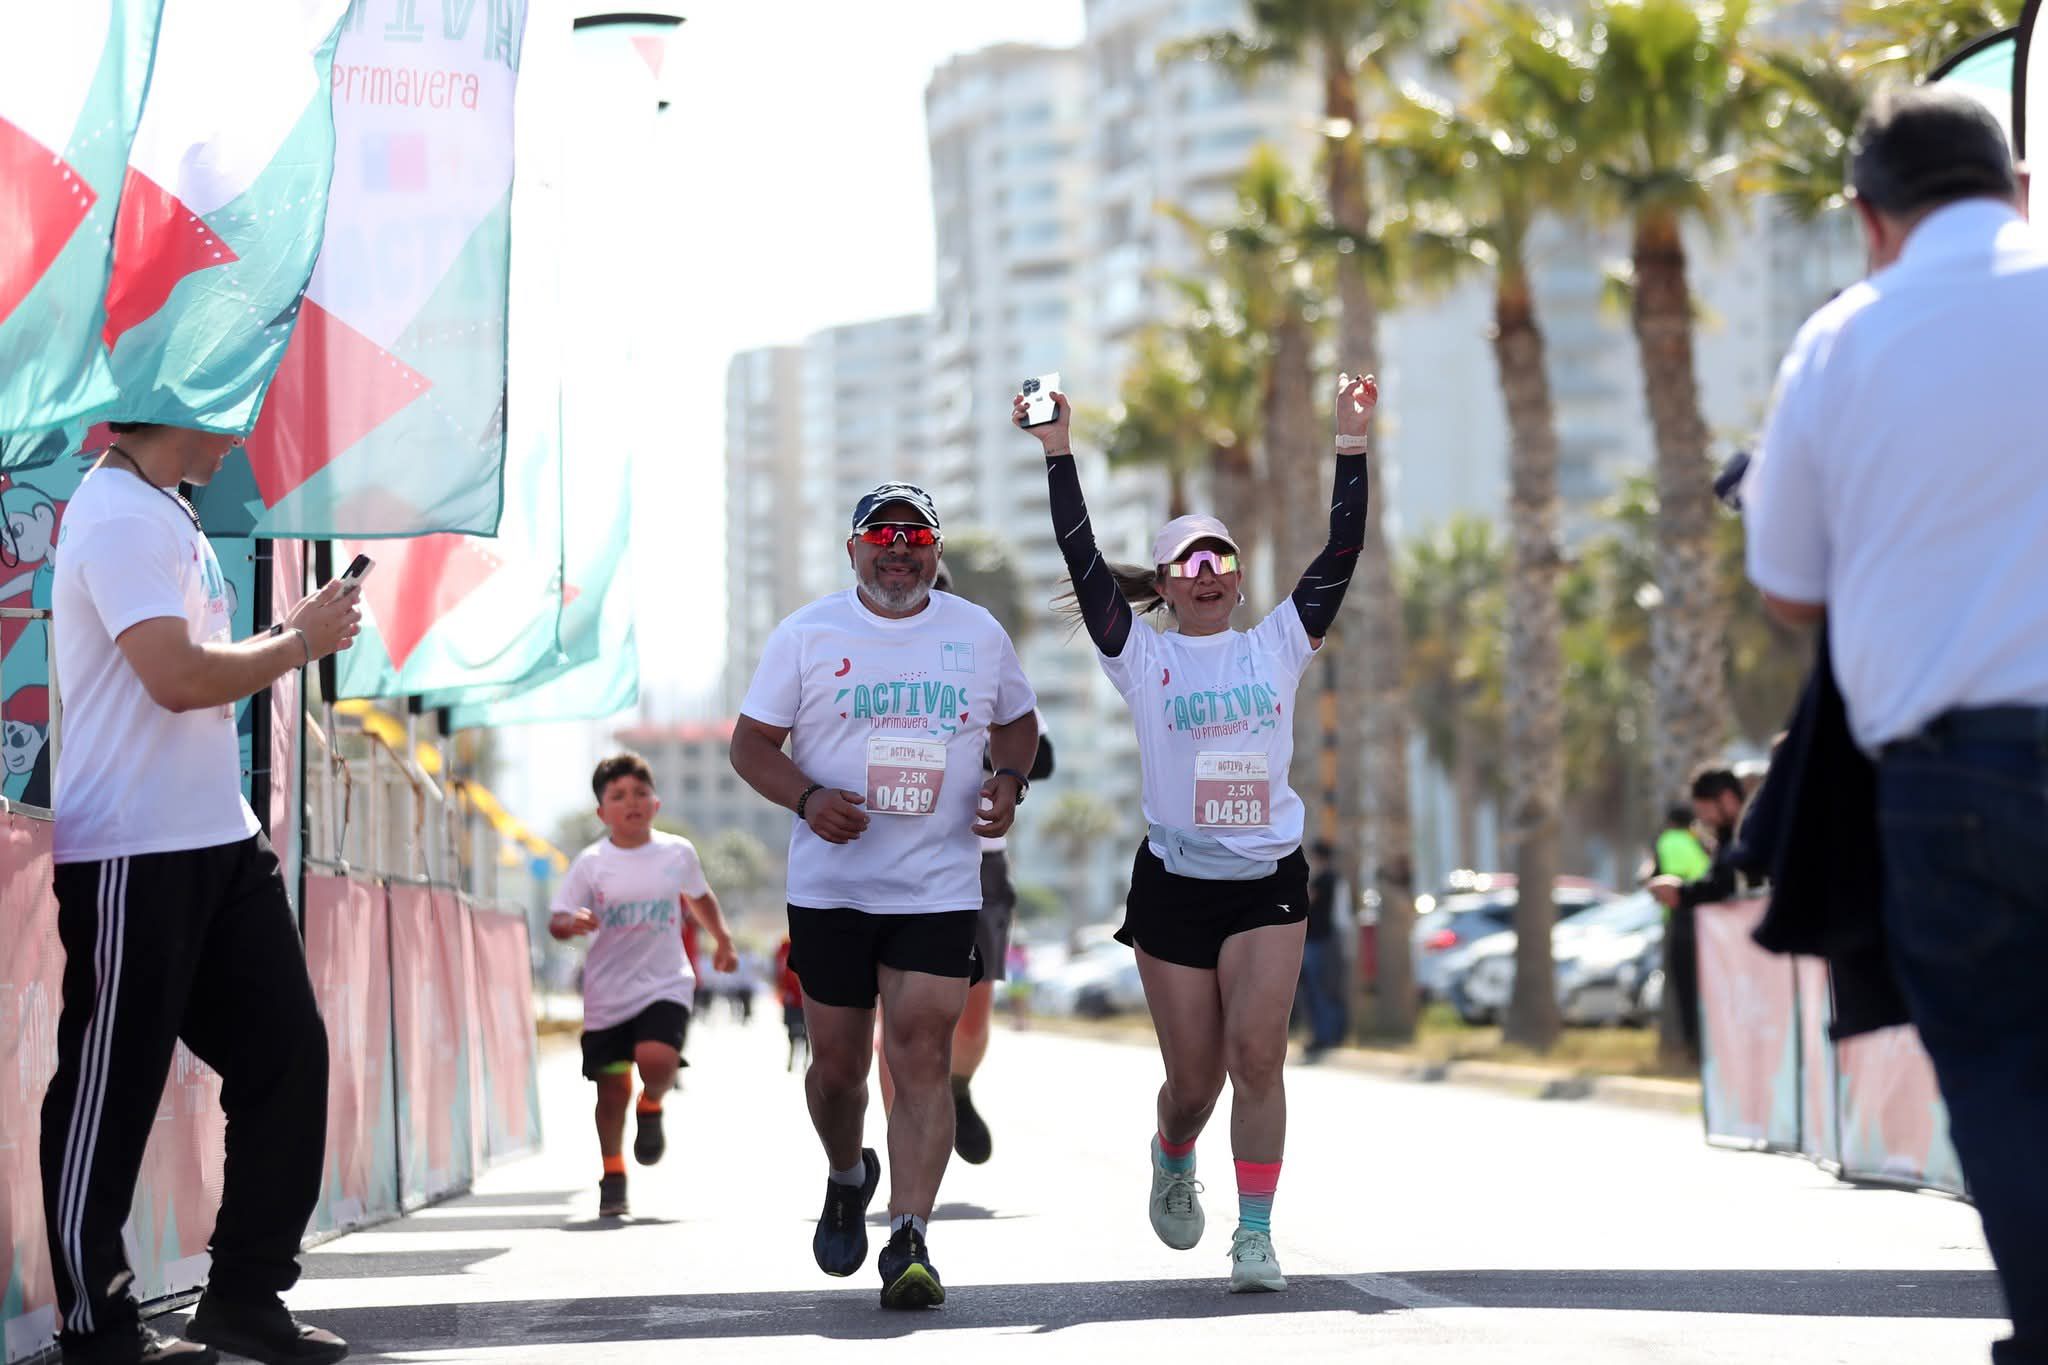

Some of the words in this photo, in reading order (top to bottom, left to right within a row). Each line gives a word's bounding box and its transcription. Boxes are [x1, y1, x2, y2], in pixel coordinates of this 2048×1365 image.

[854, 681, 957, 719] ACTIVA
[1174, 683, 1273, 731] ACTIVA
[899, 771, 928, 785] 2,5K
[1227, 784, 1255, 797] 2,5K
[876, 785, 934, 812] 0439
[1205, 799, 1262, 825] 0438
